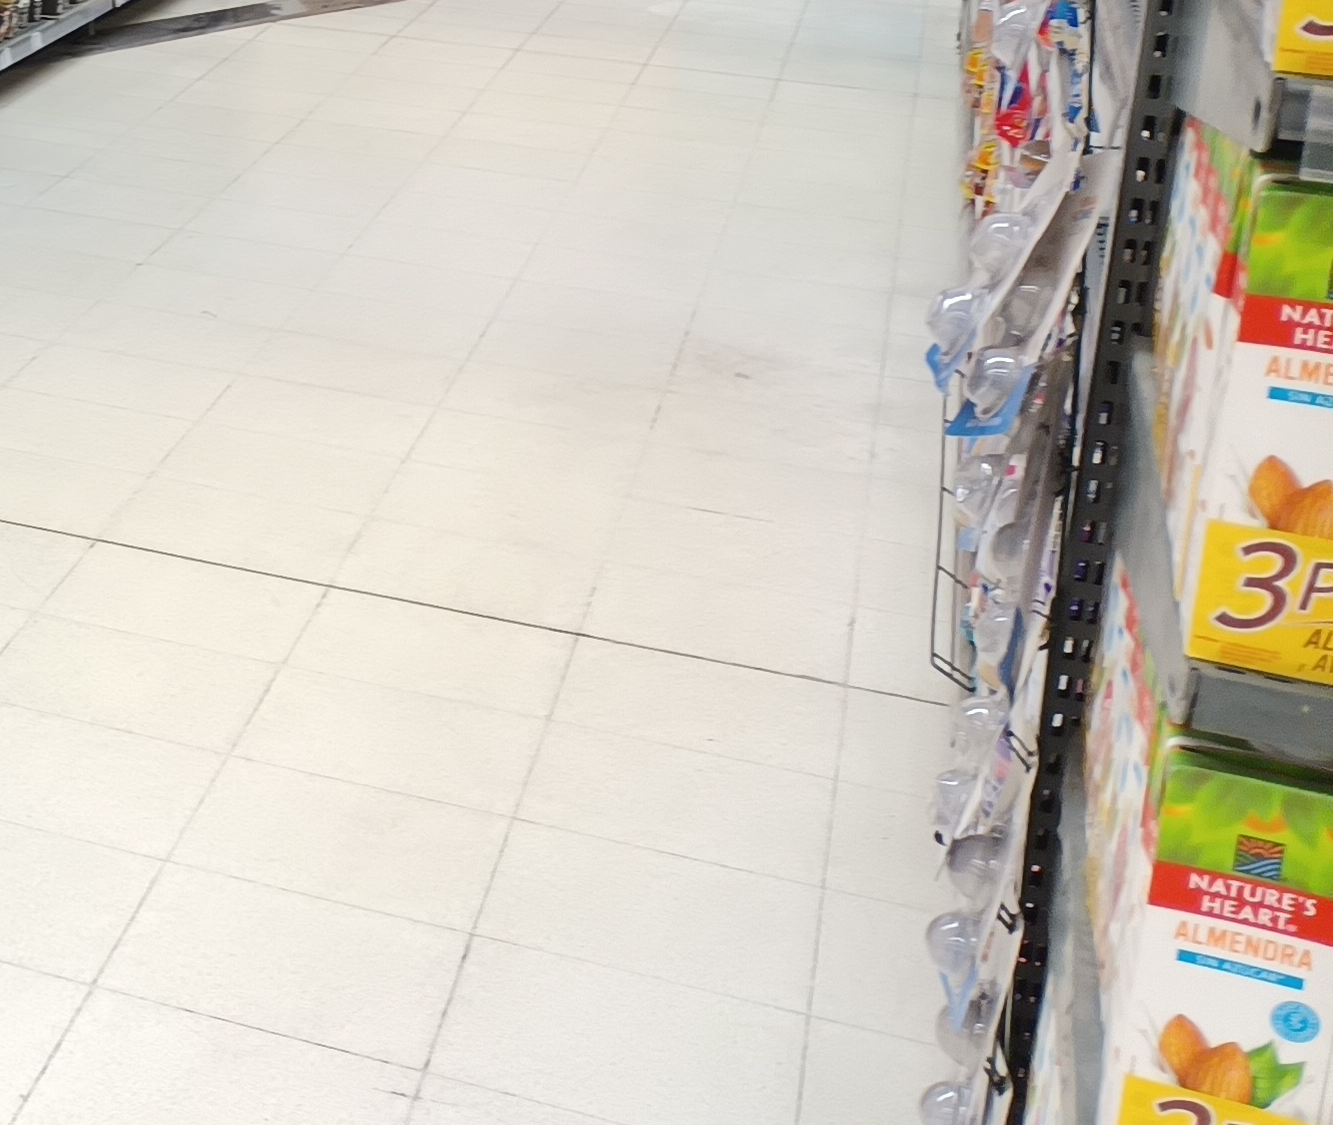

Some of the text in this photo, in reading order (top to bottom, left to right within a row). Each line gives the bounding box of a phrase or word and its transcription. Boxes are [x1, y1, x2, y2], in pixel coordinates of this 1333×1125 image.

[1189, 872, 1318, 917] NATURE'S
[1200, 894, 1293, 931] HEART
[1173, 920, 1313, 971] ALMENDRA
